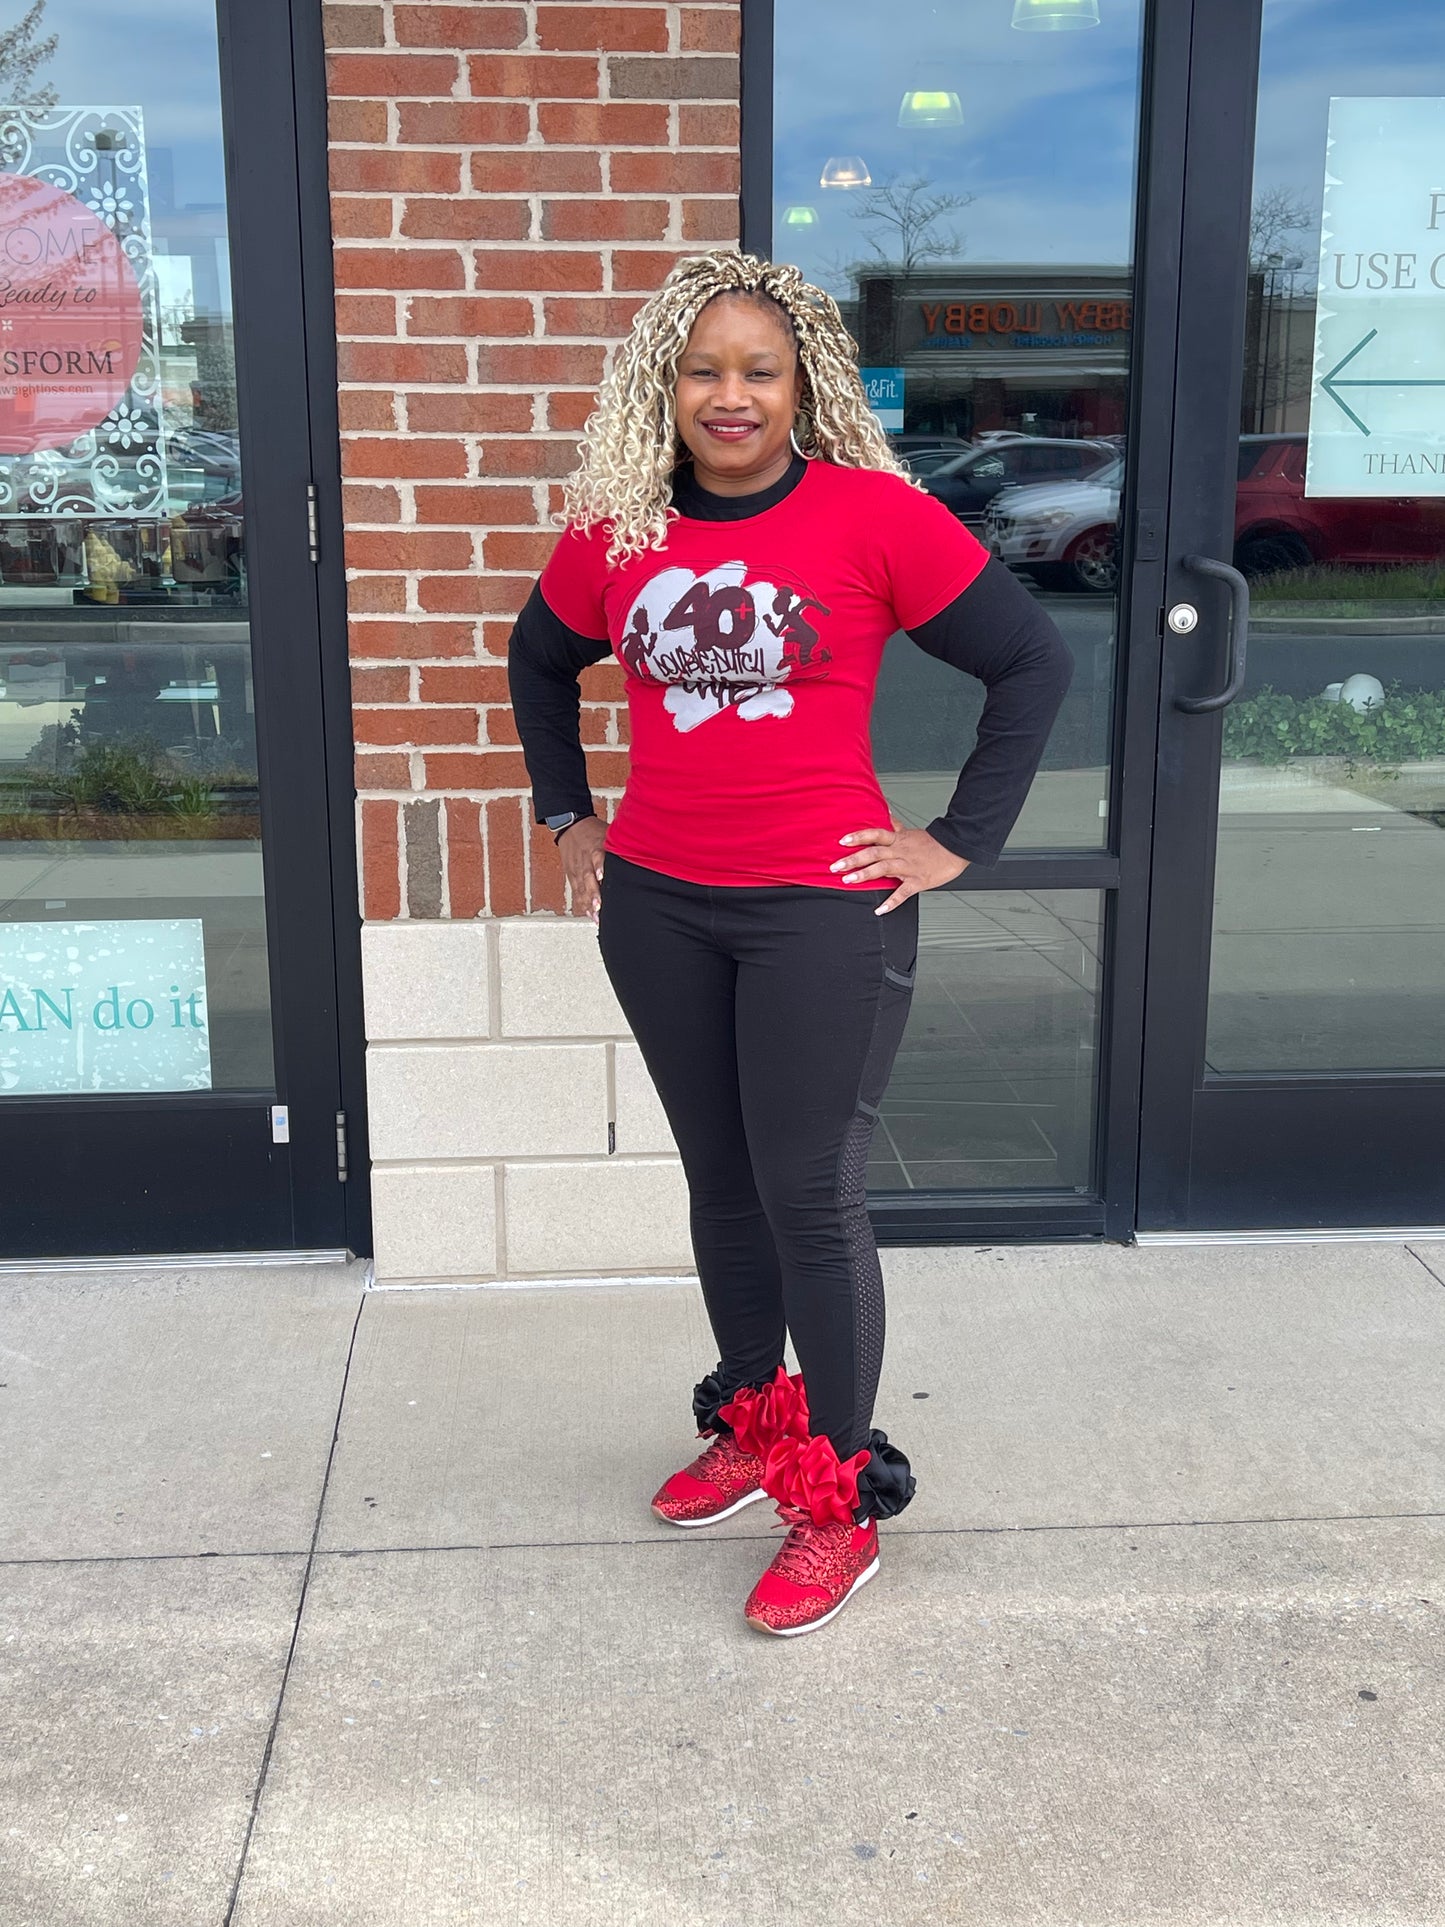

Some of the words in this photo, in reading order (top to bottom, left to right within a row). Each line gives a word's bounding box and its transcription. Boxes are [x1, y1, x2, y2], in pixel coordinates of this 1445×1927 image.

[1334, 253, 1417, 290] USE
[73, 285, 97, 304] to
[3, 350, 115, 376] SFORM
[0, 988, 74, 1031] AN
[93, 986, 154, 1029] do
[169, 985, 204, 1028] it
